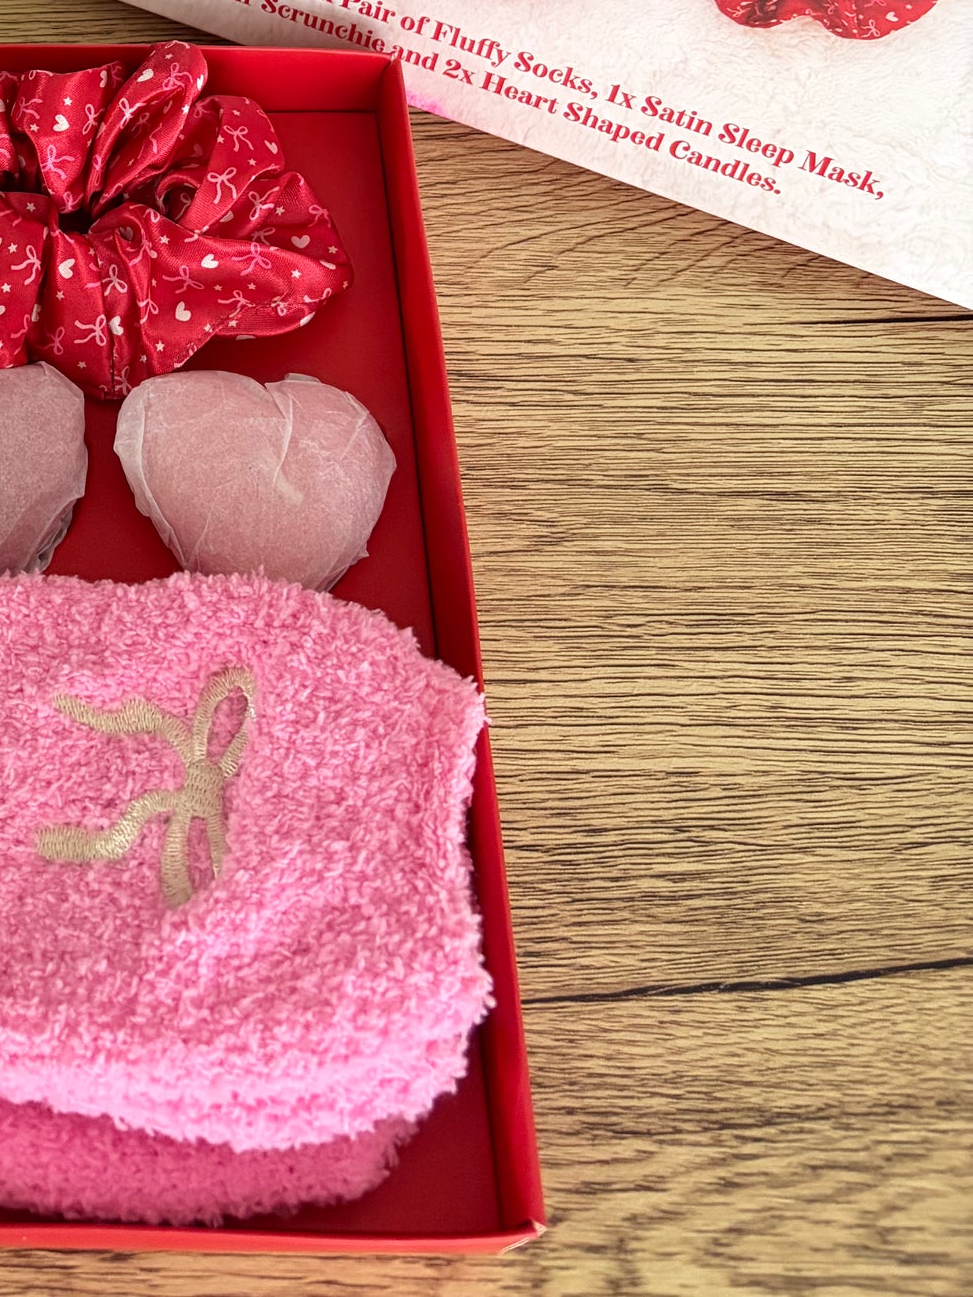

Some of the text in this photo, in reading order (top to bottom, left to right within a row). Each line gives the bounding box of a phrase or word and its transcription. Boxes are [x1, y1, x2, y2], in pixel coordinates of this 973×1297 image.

[390, 46, 438, 71] and
[443, 60, 474, 85] 2x
[481, 71, 558, 114] Heart
[564, 103, 664, 150] Shaped
[670, 141, 780, 194] Candles.
[401, 17, 429, 34] of
[429, 20, 510, 66] Fluffy
[515, 52, 597, 98] Socks,
[608, 86, 634, 109] 1x
[641, 97, 712, 135] Satin
[719, 124, 794, 165] Sleep
[799, 152, 884, 199] Mask,
